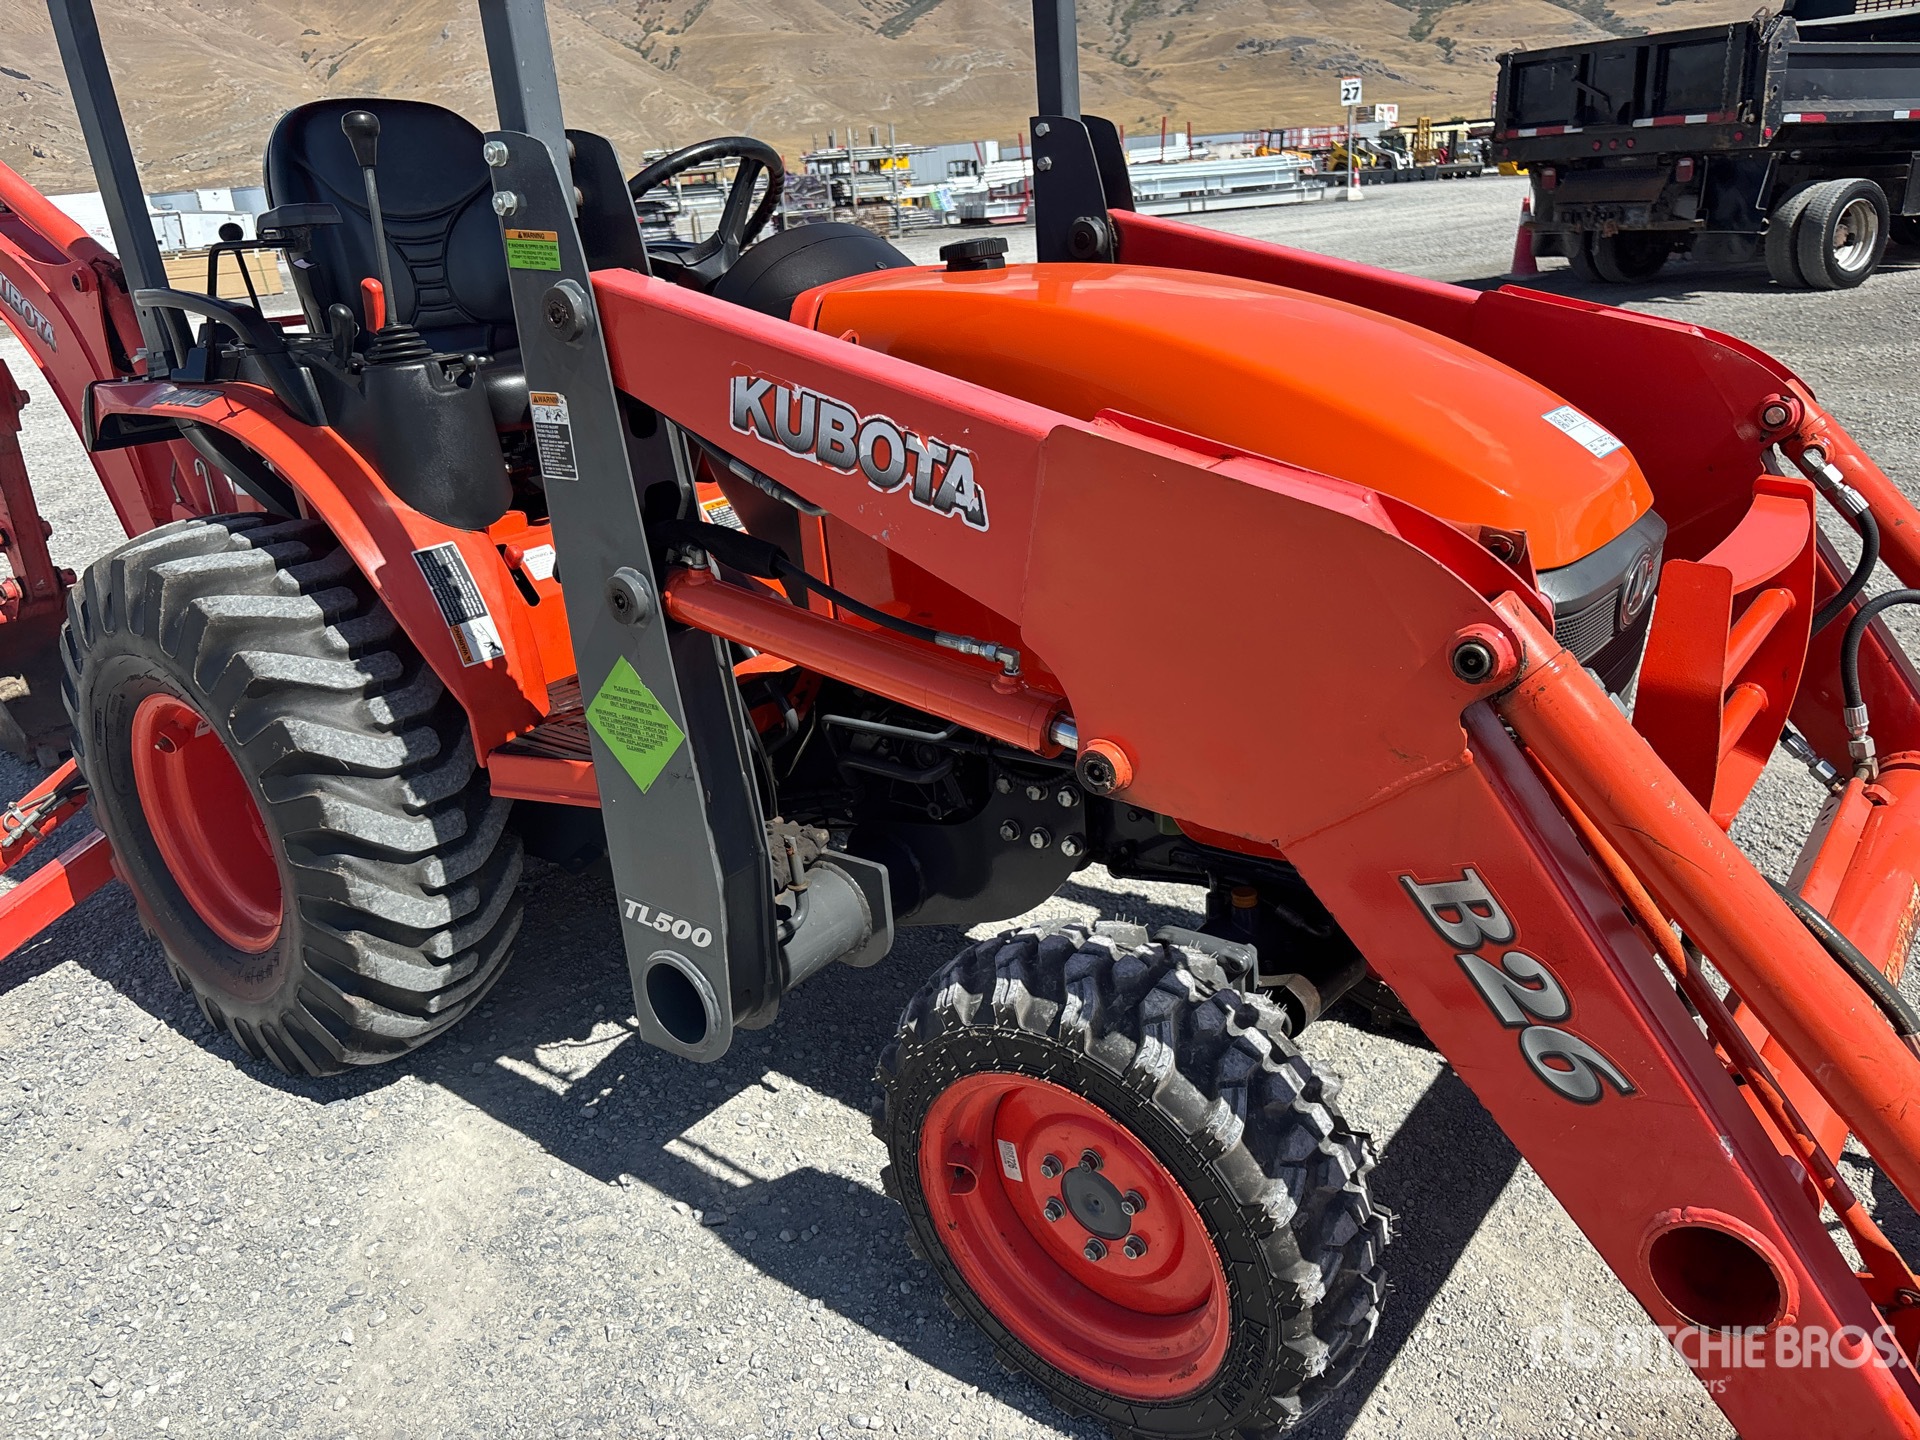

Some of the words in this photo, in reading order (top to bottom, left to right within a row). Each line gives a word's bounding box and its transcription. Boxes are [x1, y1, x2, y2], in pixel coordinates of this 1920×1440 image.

[1342, 87, 1359, 101] 27
[730, 375, 988, 531] KUBOTA
[454, 626, 469, 656] WARNING
[624, 898, 712, 948] TL500
[1400, 867, 1636, 1104] B26
[1222, 1321, 1268, 1409] TITAN
